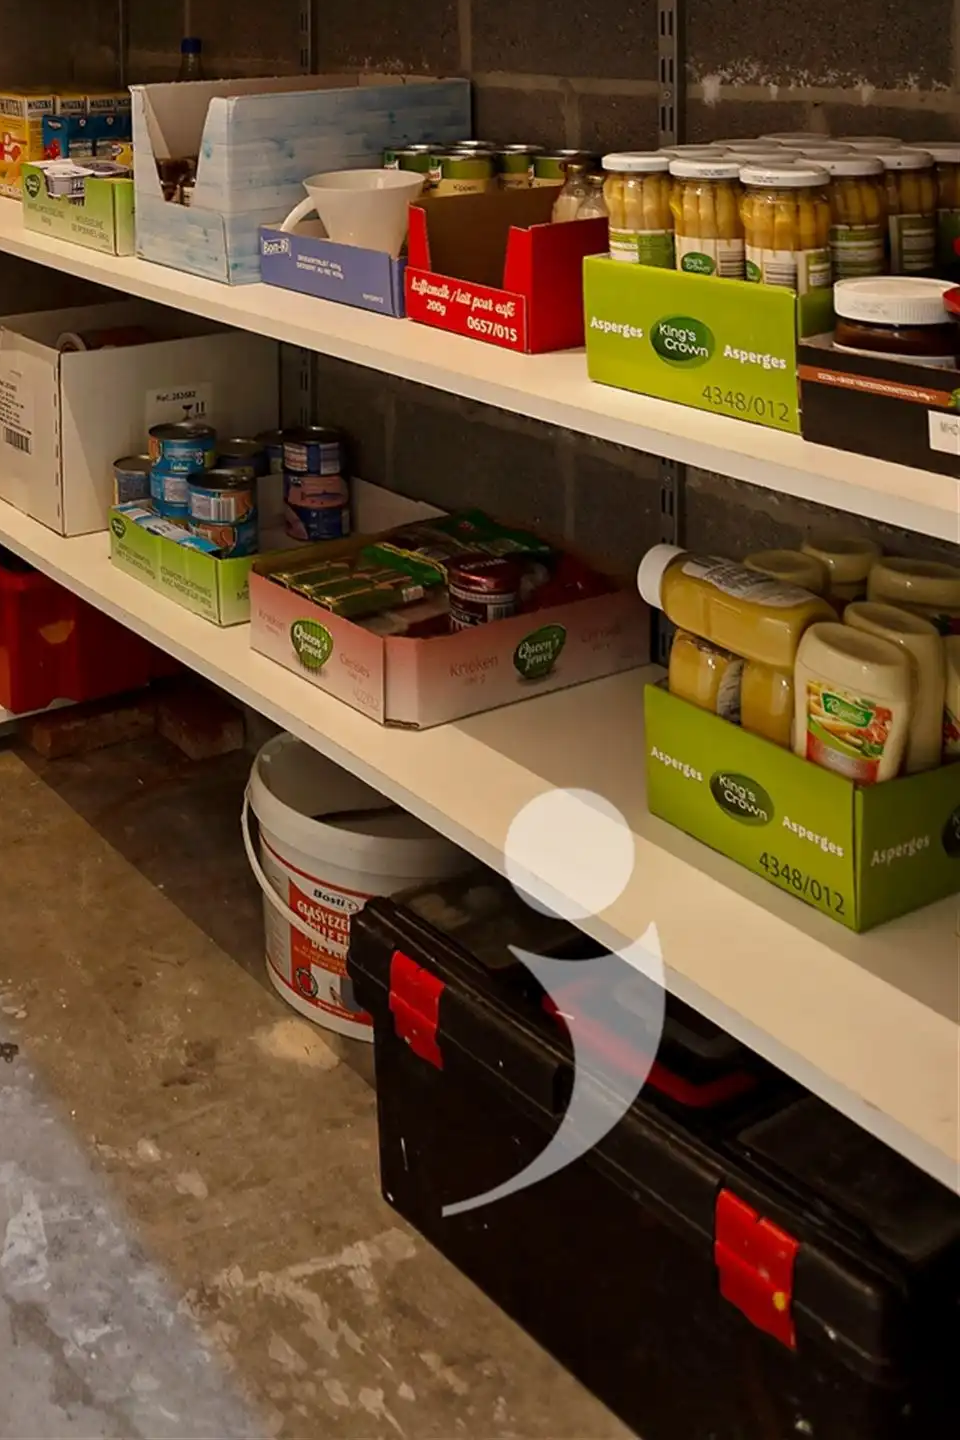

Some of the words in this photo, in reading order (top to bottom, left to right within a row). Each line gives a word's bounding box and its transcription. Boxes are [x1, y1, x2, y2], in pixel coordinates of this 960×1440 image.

[426, 298, 447, 317] 200g
[466, 315, 518, 343] 0657/015
[589, 315, 644, 340] Asperges
[658, 323, 698, 344] King's
[663, 337, 709, 360] Crown
[722, 343, 787, 371] Asperges
[700, 384, 790, 423] 4348/012
[293, 623, 329, 652] Queen's
[517, 633, 561, 660] Queen's
[448, 654, 500, 678] Krieken
[649, 745, 704, 782] Asperges
[717, 772, 757, 803] King's
[723, 790, 769, 822] Crown
[782, 815, 845, 858] Asperges
[869, 834, 931, 868] Asperges
[758, 851, 846, 916] 4348/012
